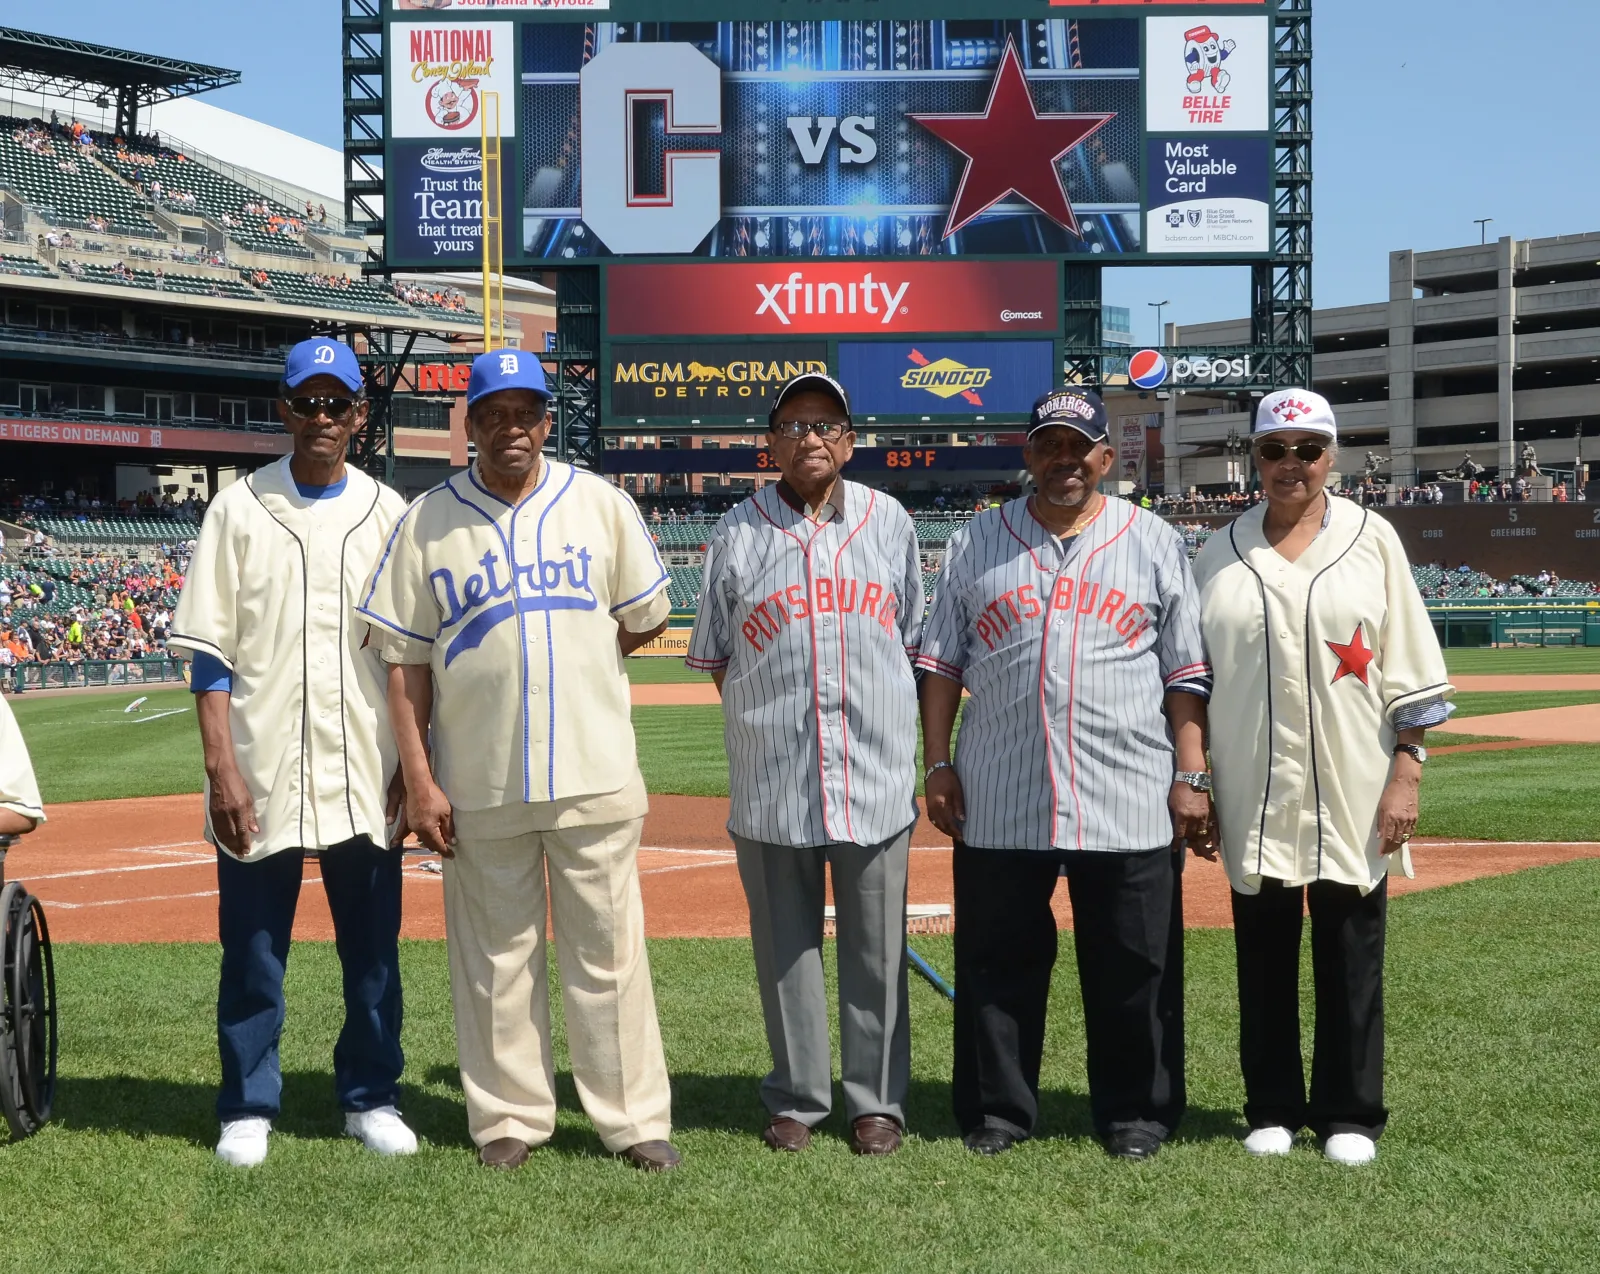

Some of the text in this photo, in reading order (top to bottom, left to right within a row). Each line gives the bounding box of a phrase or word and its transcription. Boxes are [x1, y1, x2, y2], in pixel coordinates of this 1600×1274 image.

[410, 29, 494, 63] NATIONAL
[411, 57, 493, 83] Coney Island
[1182, 96, 1231, 123] BELLE TIRE
[1165, 142, 1209, 157] Most
[1165, 159, 1237, 175] Valuable
[421, 177, 483, 191] Trust the
[1165, 177, 1206, 193] Card
[414, 193, 492, 219] Team
[418, 222, 446, 236] that
[434, 240, 474, 255] yours
[314, 345, 335, 365] D
[499, 354, 519, 376] D
[614, 361, 828, 383] MGM GRAND
[1172, 354, 1252, 383] pepsi
[905, 371, 987, 386] SUNOCO
[1036, 396, 1096, 420] MONARCHS
[11, 424, 59, 439] TIGERS
[62, 427, 81, 440] ON
[84, 428, 140, 444] DEMAND
[1508, 507, 1518, 523] 5
[1422, 529, 1443, 538] COBB
[1490, 527, 1537, 537] GREENBERG
[657, 636, 688, 649] Times
